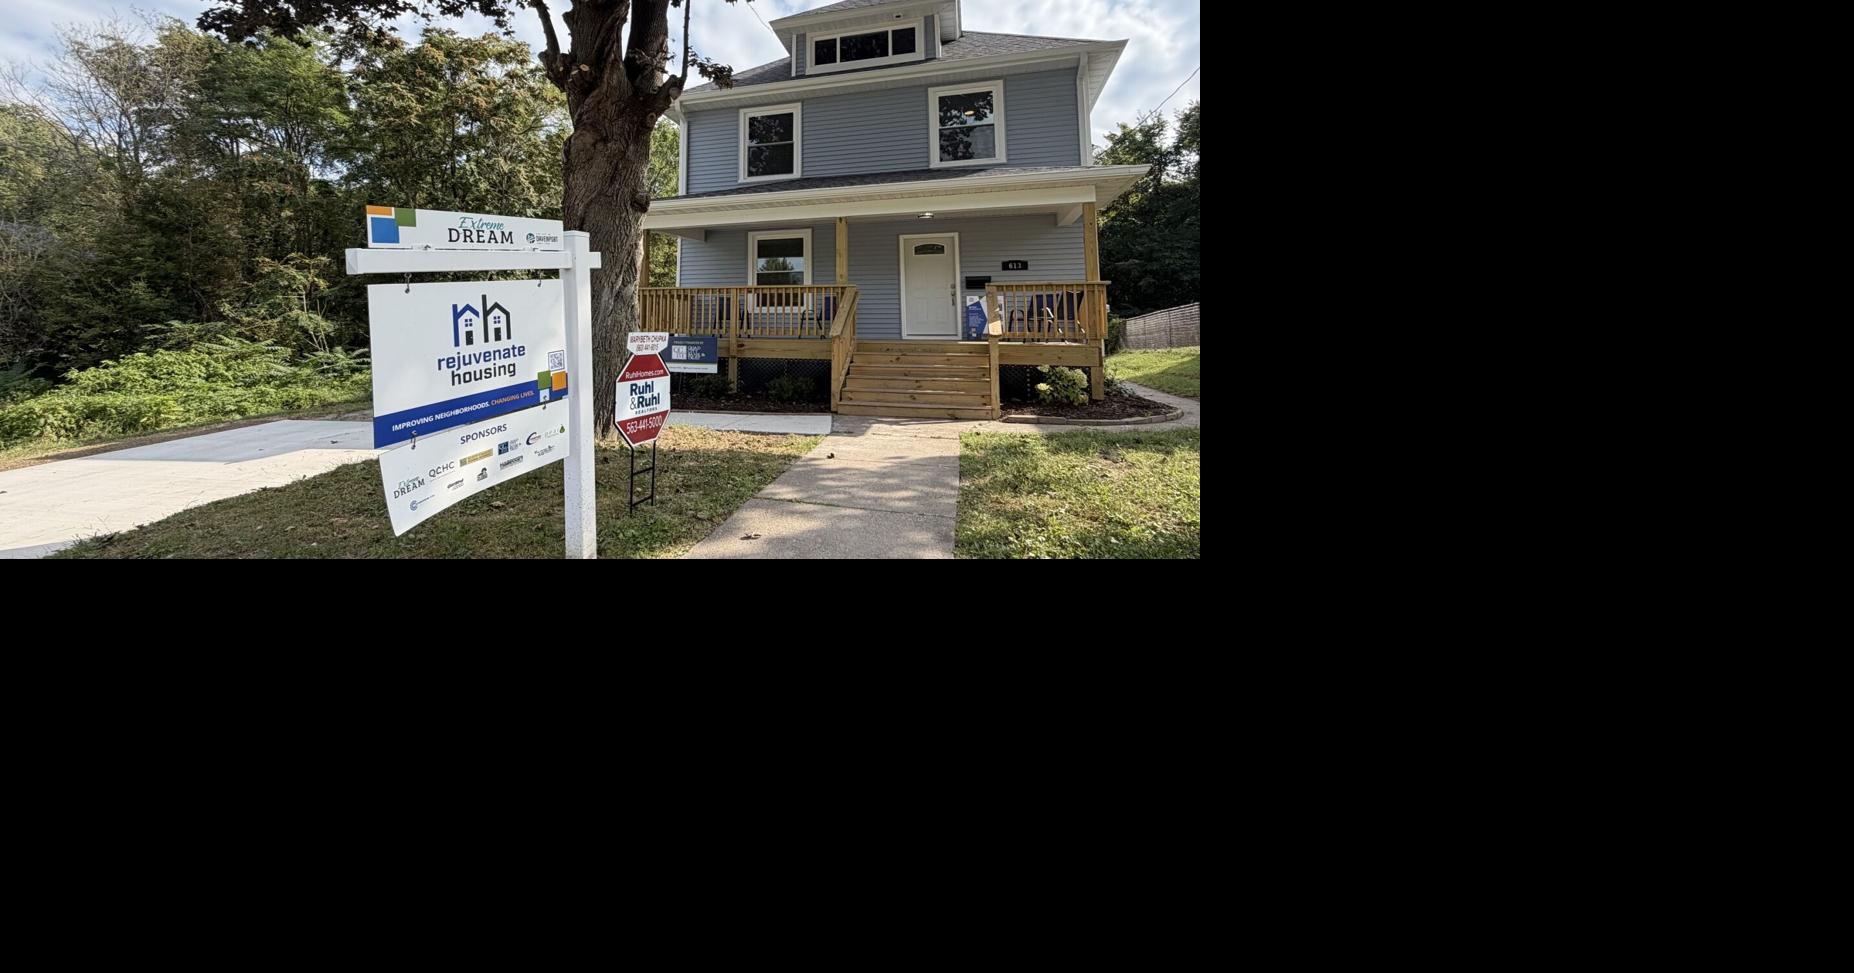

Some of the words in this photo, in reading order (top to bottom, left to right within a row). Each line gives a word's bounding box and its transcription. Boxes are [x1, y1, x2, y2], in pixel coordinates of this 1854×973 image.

[458, 216, 505, 231] Extreme
[447, 227, 514, 245] DREAM
[535, 235, 559, 243] DAVENPORT
[437, 344, 526, 371] rejuvenate
[451, 362, 516, 386] housing
[625, 369, 664, 379] RuhlHomes.com
[630, 381, 654, 396] Ruhl
[392, 415, 434, 432] IMPROVING
[434, 401, 490, 421] NEIGHBORHOODS.
[490, 393, 521, 406] CHANGING
[520, 390, 535, 399] LIVES.
[634, 407, 658, 415] REALTORS
[460, 423, 508, 445] SPONSORS
[626, 415, 663, 435] 563-441-5000
[428, 461, 455, 478] QCHC
[393, 478, 426, 499] DREAM
